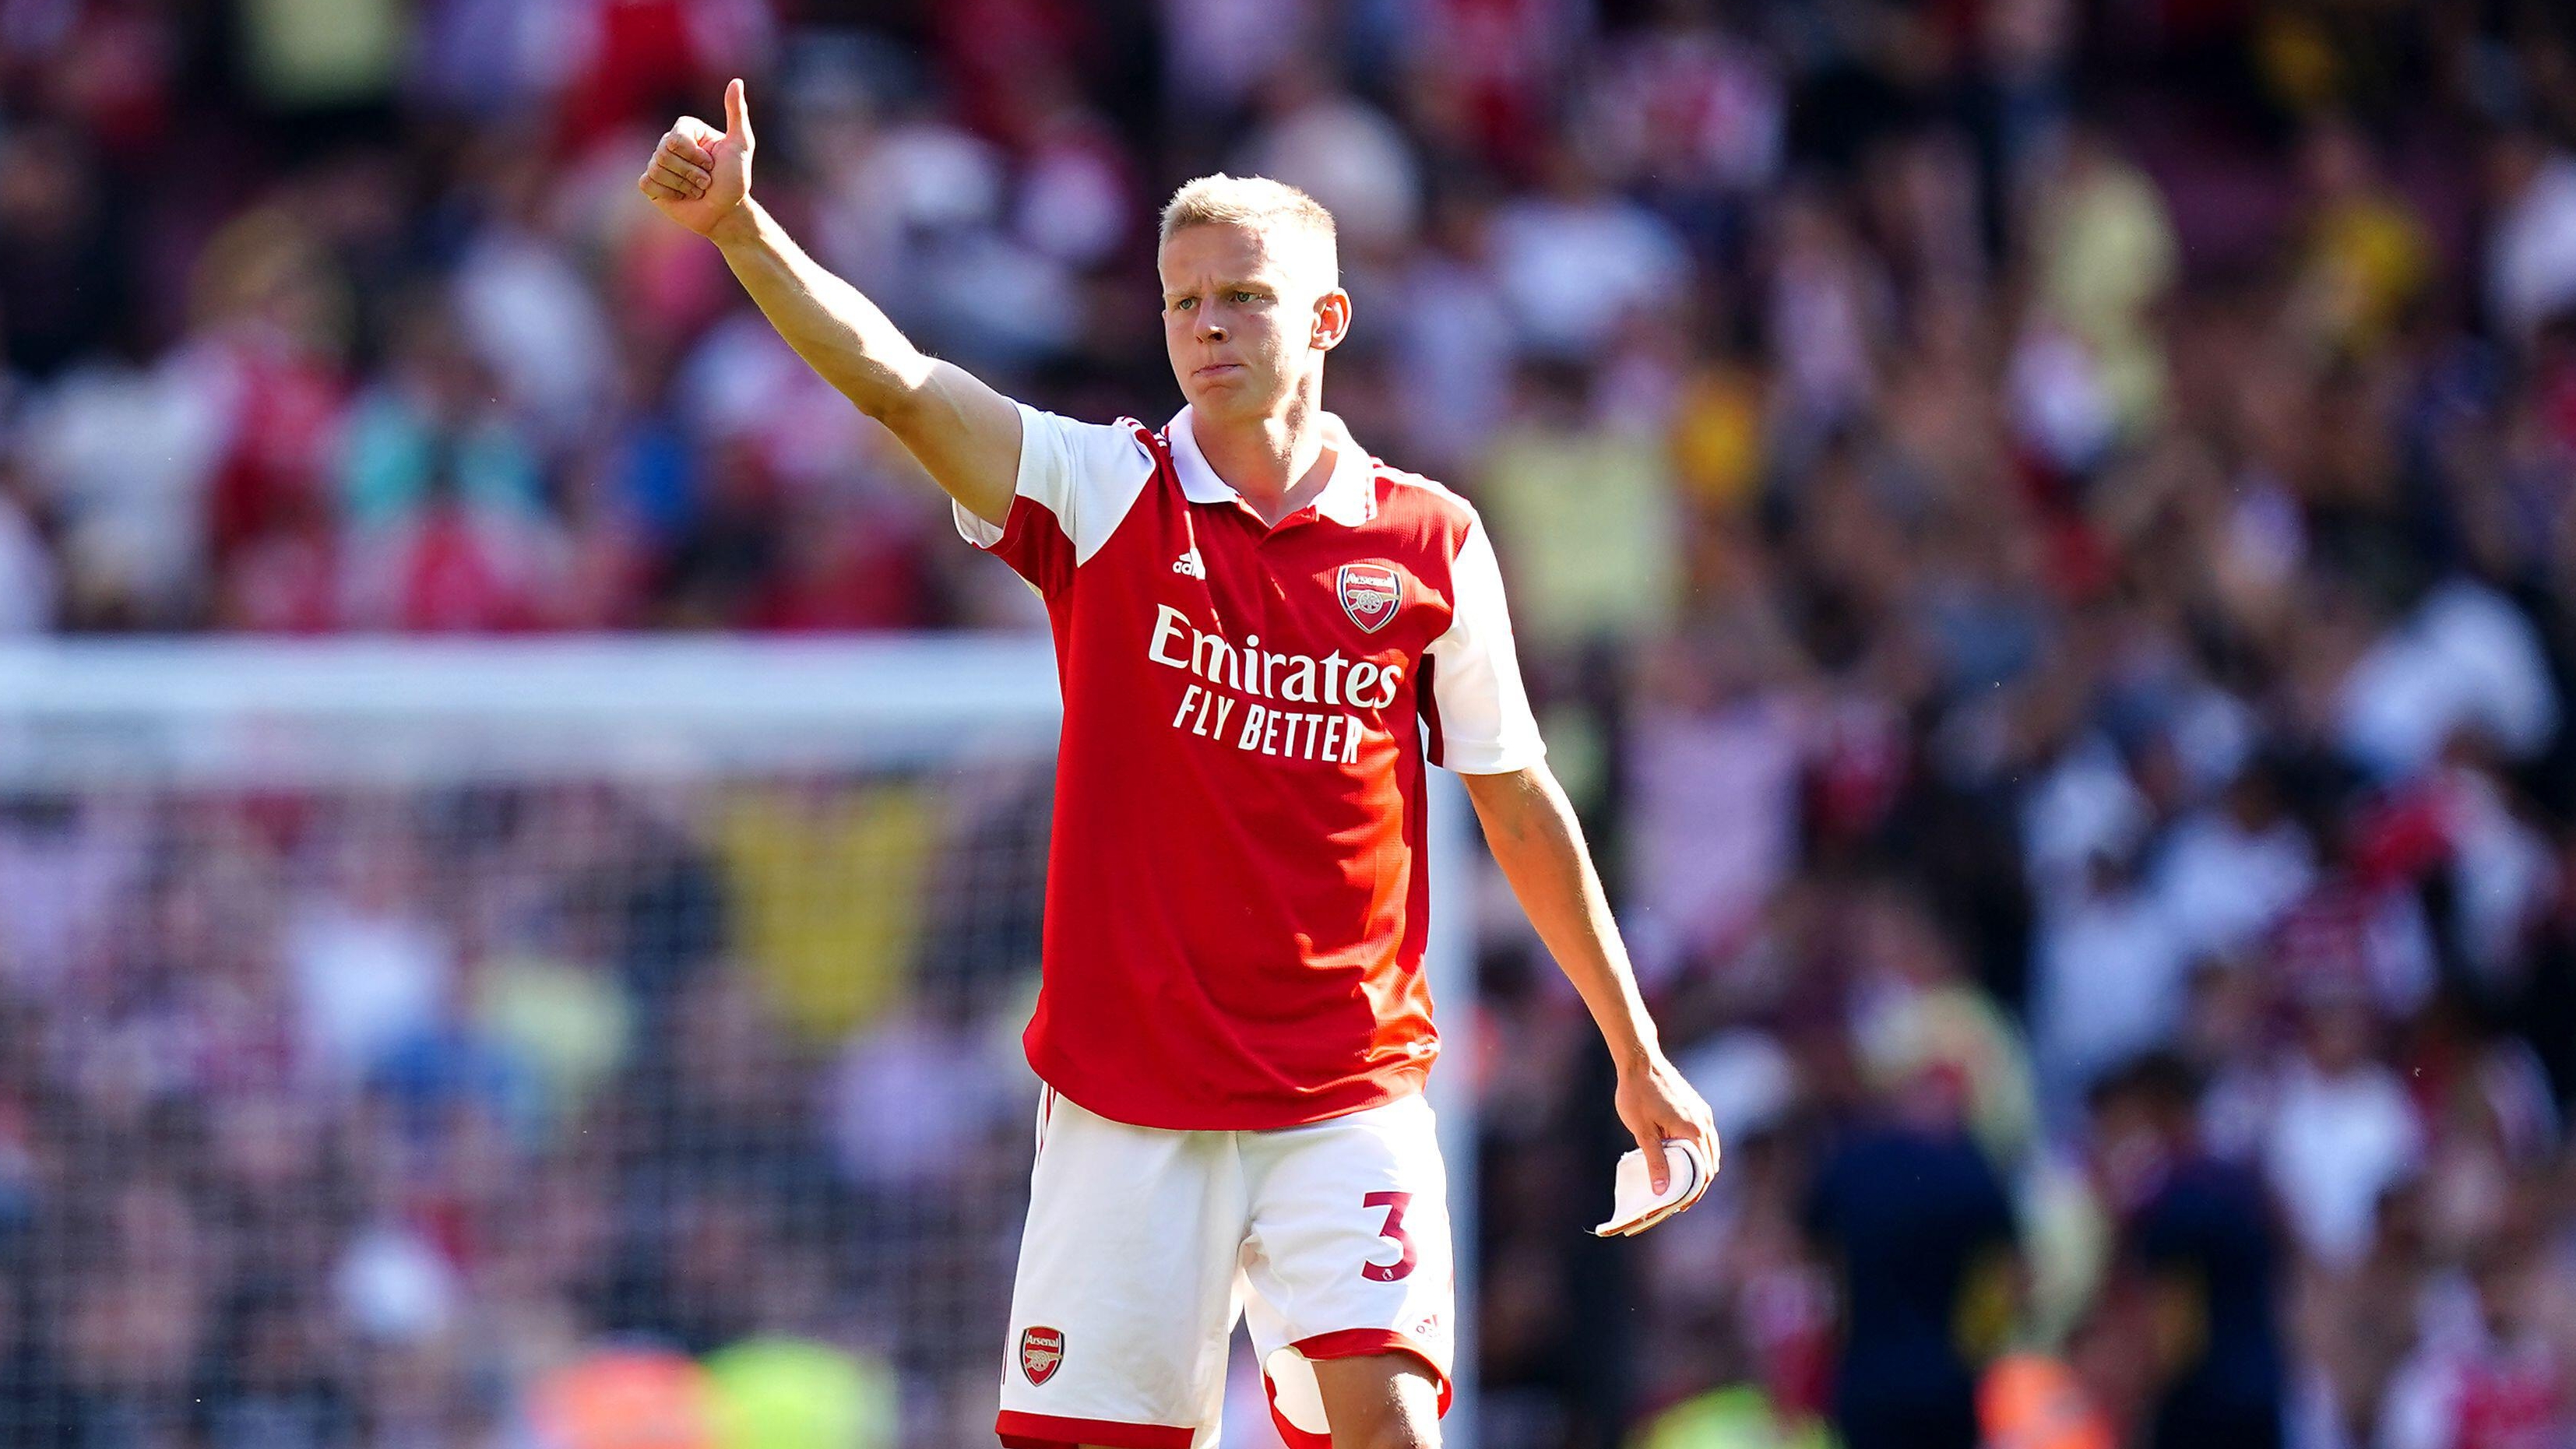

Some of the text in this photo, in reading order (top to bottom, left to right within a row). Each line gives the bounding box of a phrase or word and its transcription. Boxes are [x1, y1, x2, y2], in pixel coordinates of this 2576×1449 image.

[1149, 603, 1402, 709] Emirates
[1172, 684, 1363, 764] FLY BETTER
[1361, 1191, 1418, 1282] 3
[1026, 1335, 1059, 1348] Arsenal
